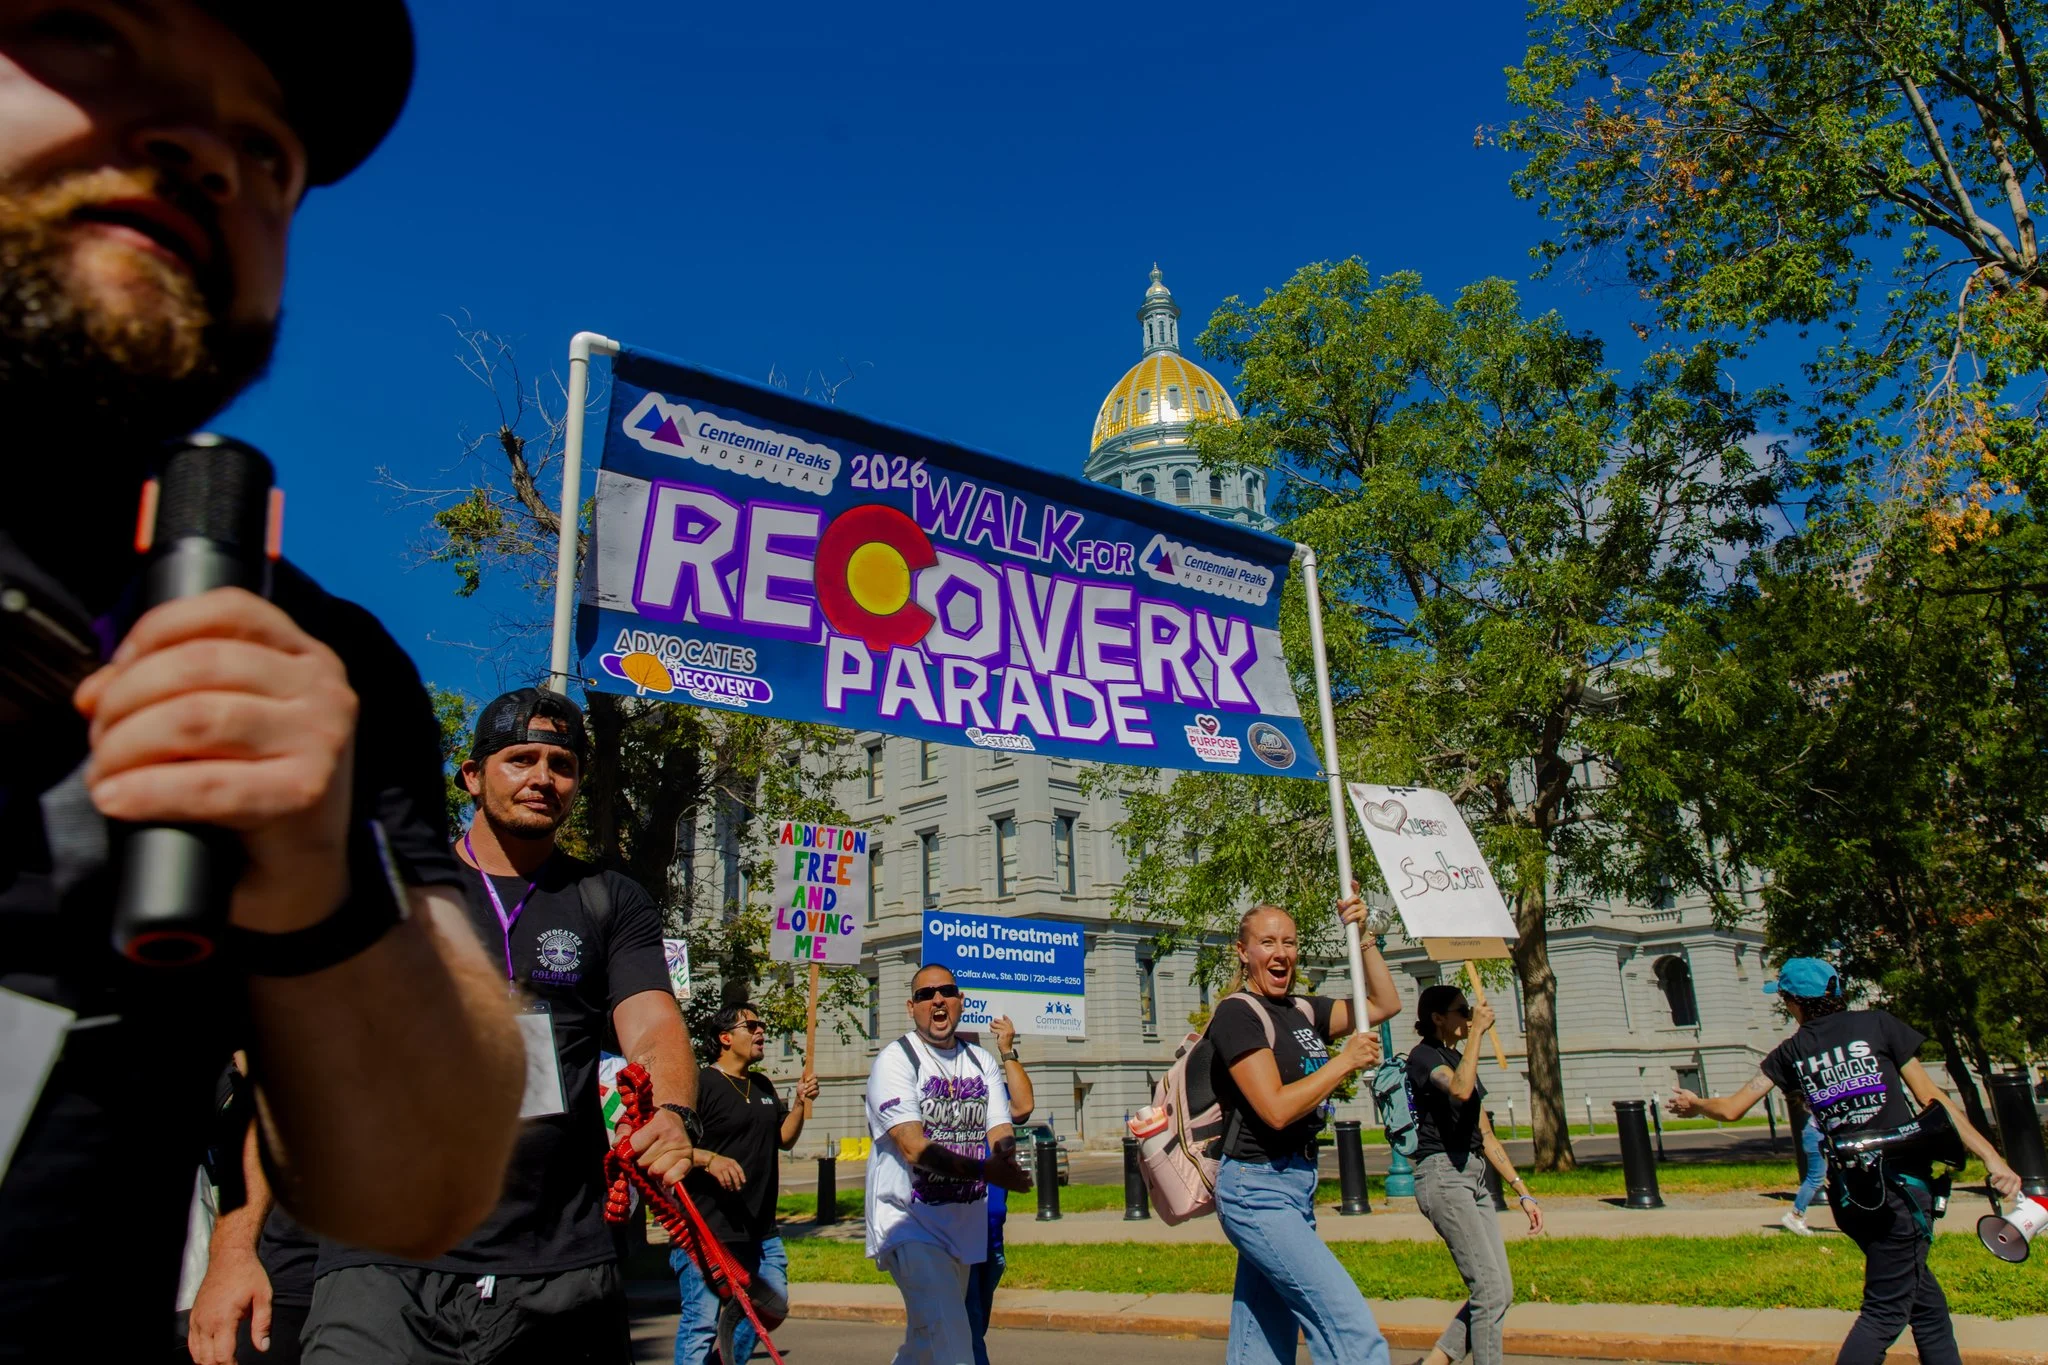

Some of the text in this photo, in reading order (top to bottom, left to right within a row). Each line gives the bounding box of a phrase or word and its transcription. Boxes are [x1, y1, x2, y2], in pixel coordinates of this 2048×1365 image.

[699, 423, 832, 471] Centennial Peaks
[700, 444, 824, 486] HOSPITAL
[850, 455, 1134, 575] 2026 WALK FOR
[1184, 555, 1267, 586] Centennial Peaks
[634, 480, 1260, 714] RECOVERY
[1185, 571, 1262, 599] HOSPITAL
[615, 629, 756, 673] ADVOCATES
[674, 670, 755, 698] RECOVERY
[824, 632, 1157, 748] PARADE
[1189, 735, 1238, 749] PURPOSE
[1197, 748, 1237, 758] PROJECT
[780, 822, 867, 854] ADDICTION
[793, 850, 853, 886] FREE
[1400, 851, 1484, 900] Sober
[791, 885, 837, 911] AND
[776, 907, 855, 936] LOVING
[929, 920, 1079, 947] Opioid Treatment
[536, 929, 582, 947] ADVOCATES
[794, 934, 827, 960] ME
[957, 943, 1055, 964] on Demand
[532, 969, 579, 983] COLORAD
[957, 970, 980, 979] Colfax
[961, 1012, 993, 1024] ation
[963, 998, 987, 1012] Day
[1036, 1016, 1081, 1027] Community
[1820, 1055, 1879, 1086] WHAT
[1810, 1072, 1883, 1104] ECOVERY
[1854, 1093, 1887, 1108] LIKE
[931, 1129, 954, 1141] BECA
